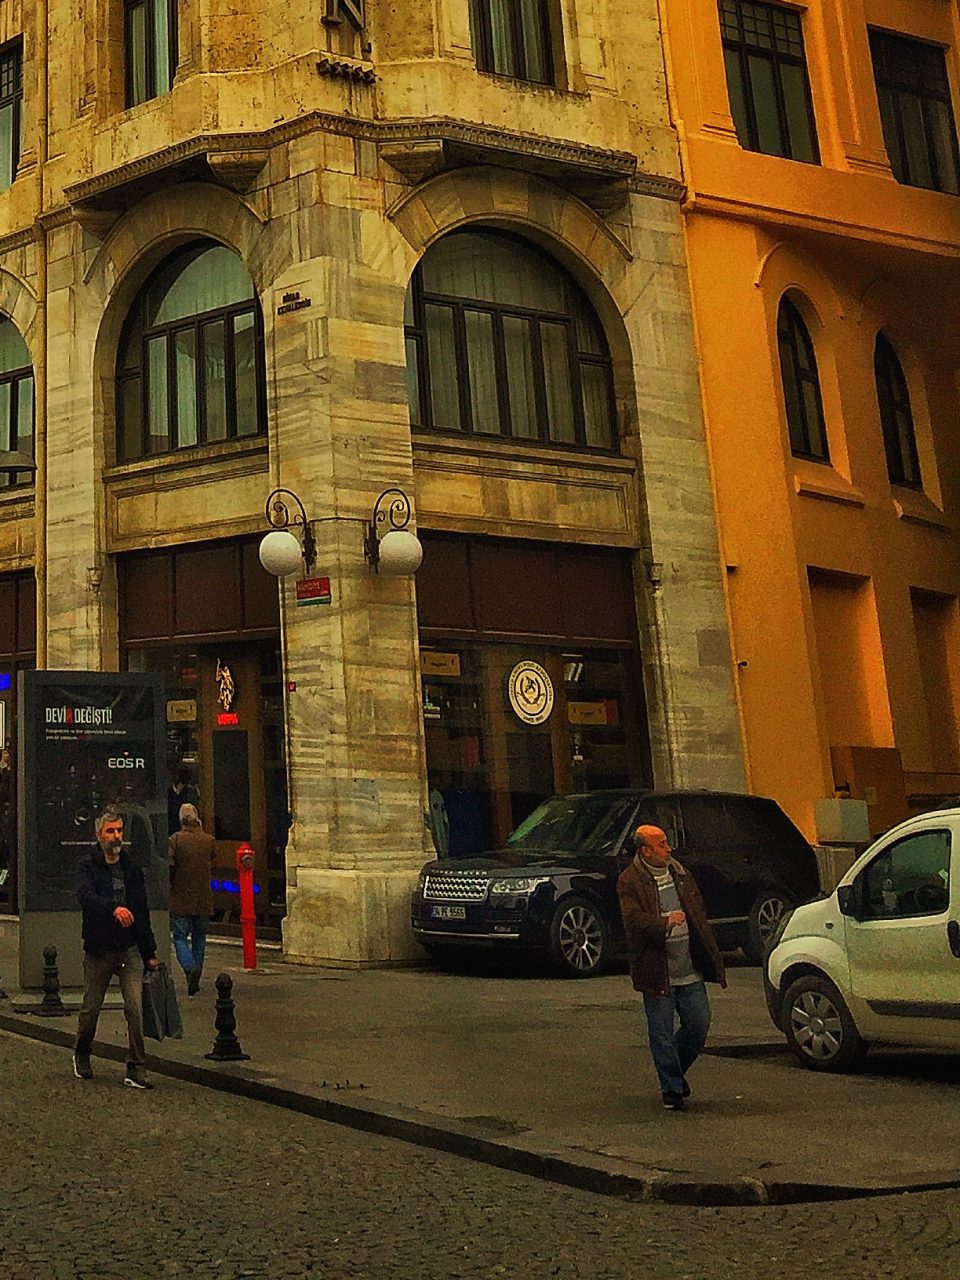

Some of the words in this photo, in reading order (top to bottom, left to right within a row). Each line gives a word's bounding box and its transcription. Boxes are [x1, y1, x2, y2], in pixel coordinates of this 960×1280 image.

[74, 705, 113, 725] DEĞİŞTİ!
[108, 758, 134, 769] EOS
[135, 758, 145, 769] R
